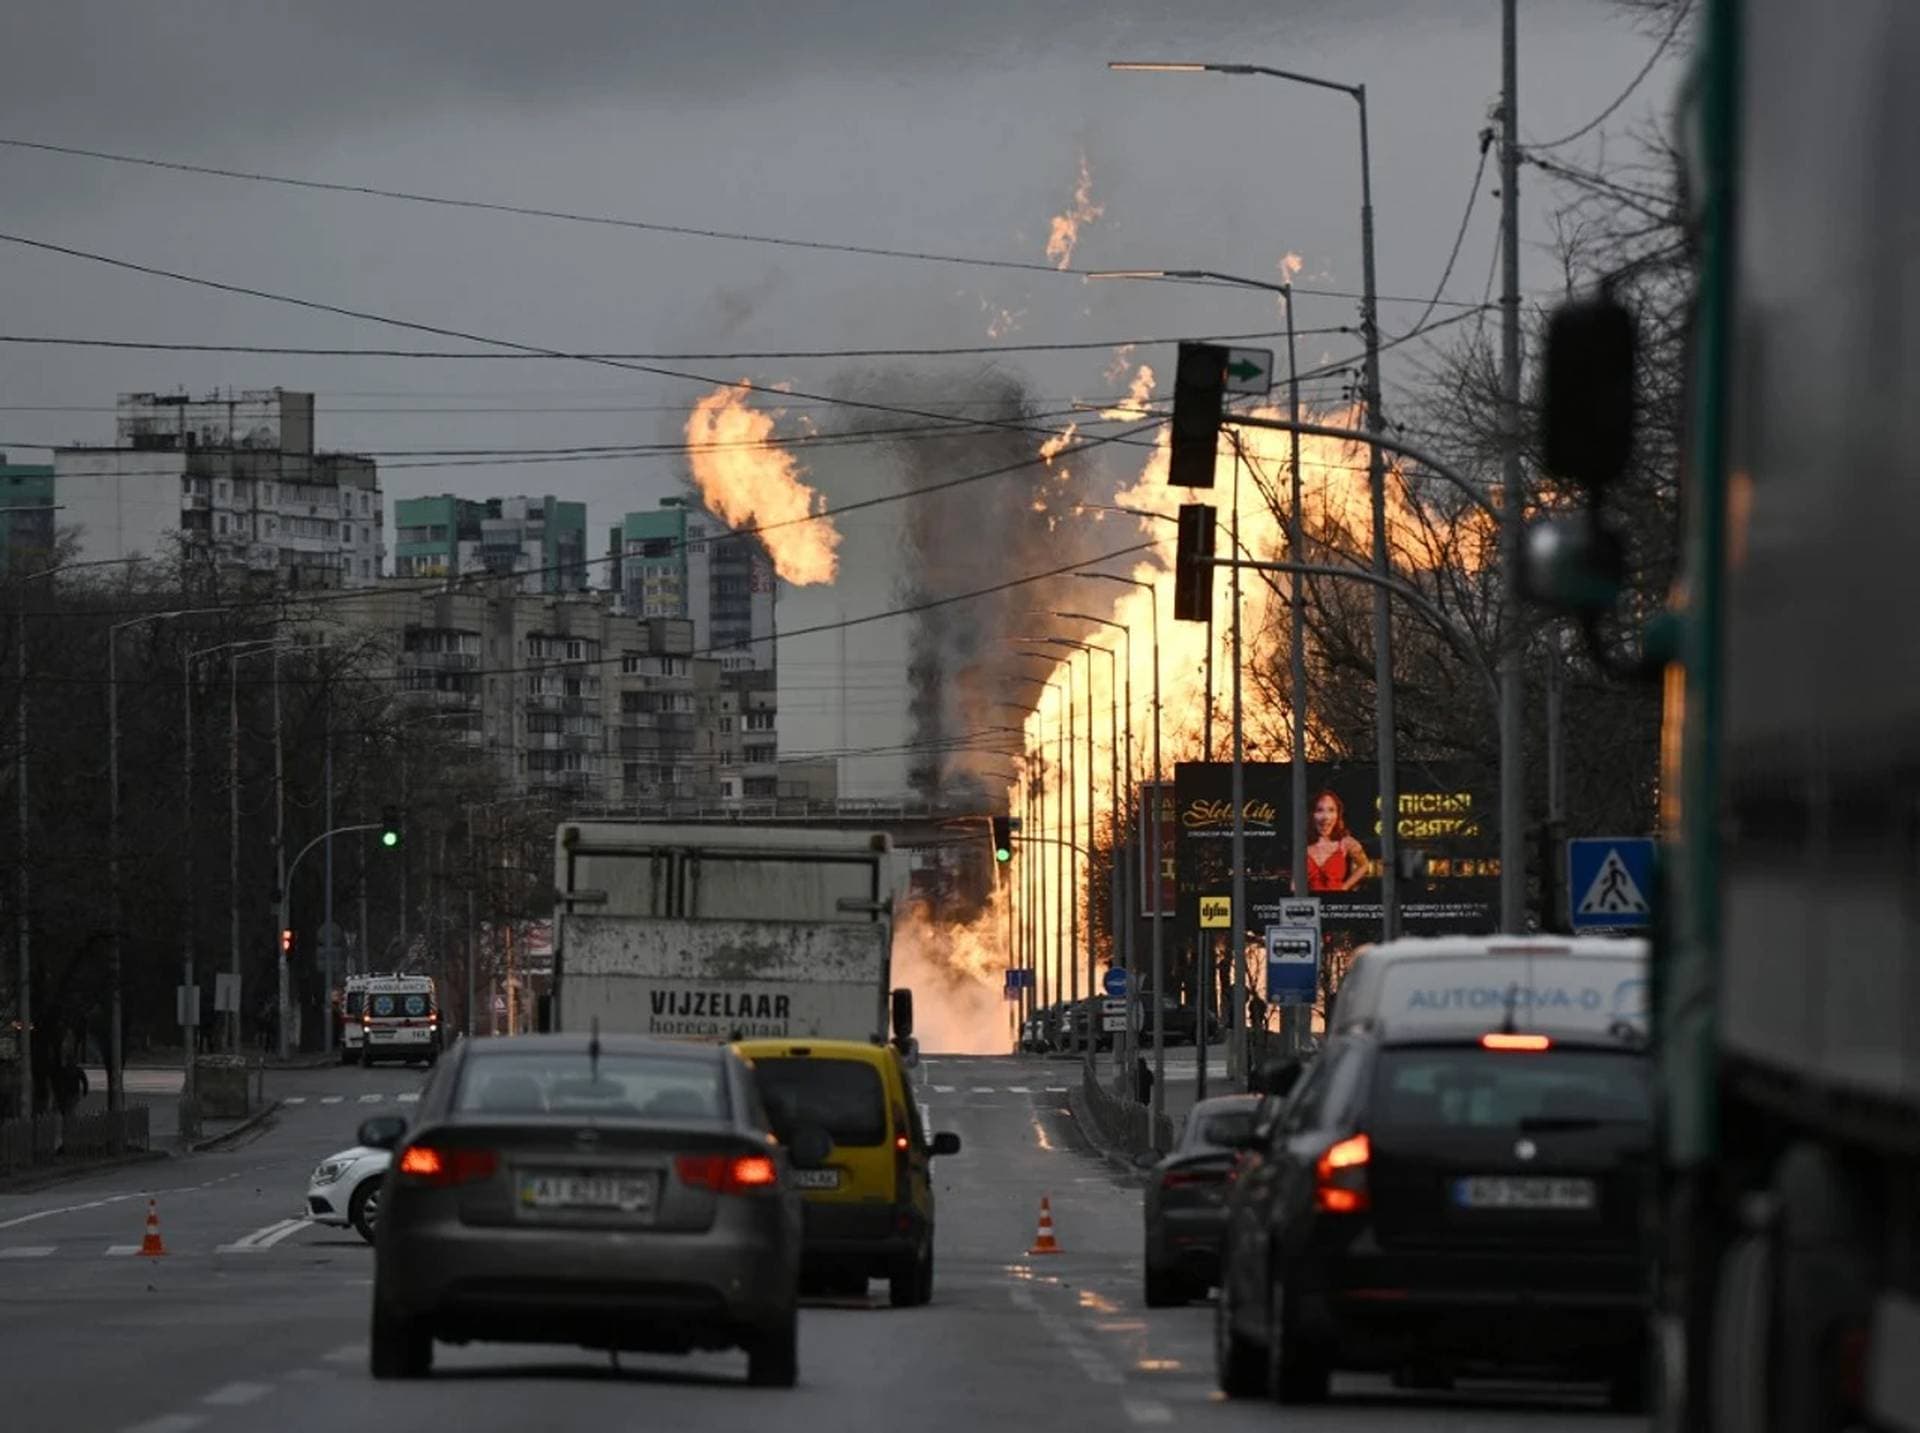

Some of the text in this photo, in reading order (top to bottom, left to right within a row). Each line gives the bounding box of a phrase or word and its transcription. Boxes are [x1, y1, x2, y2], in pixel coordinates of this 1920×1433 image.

[1182, 799, 1234, 828] Slot
[649, 989, 790, 1019] VIJZELAAR
[1409, 986, 1599, 1010] AUTONOVA-D
